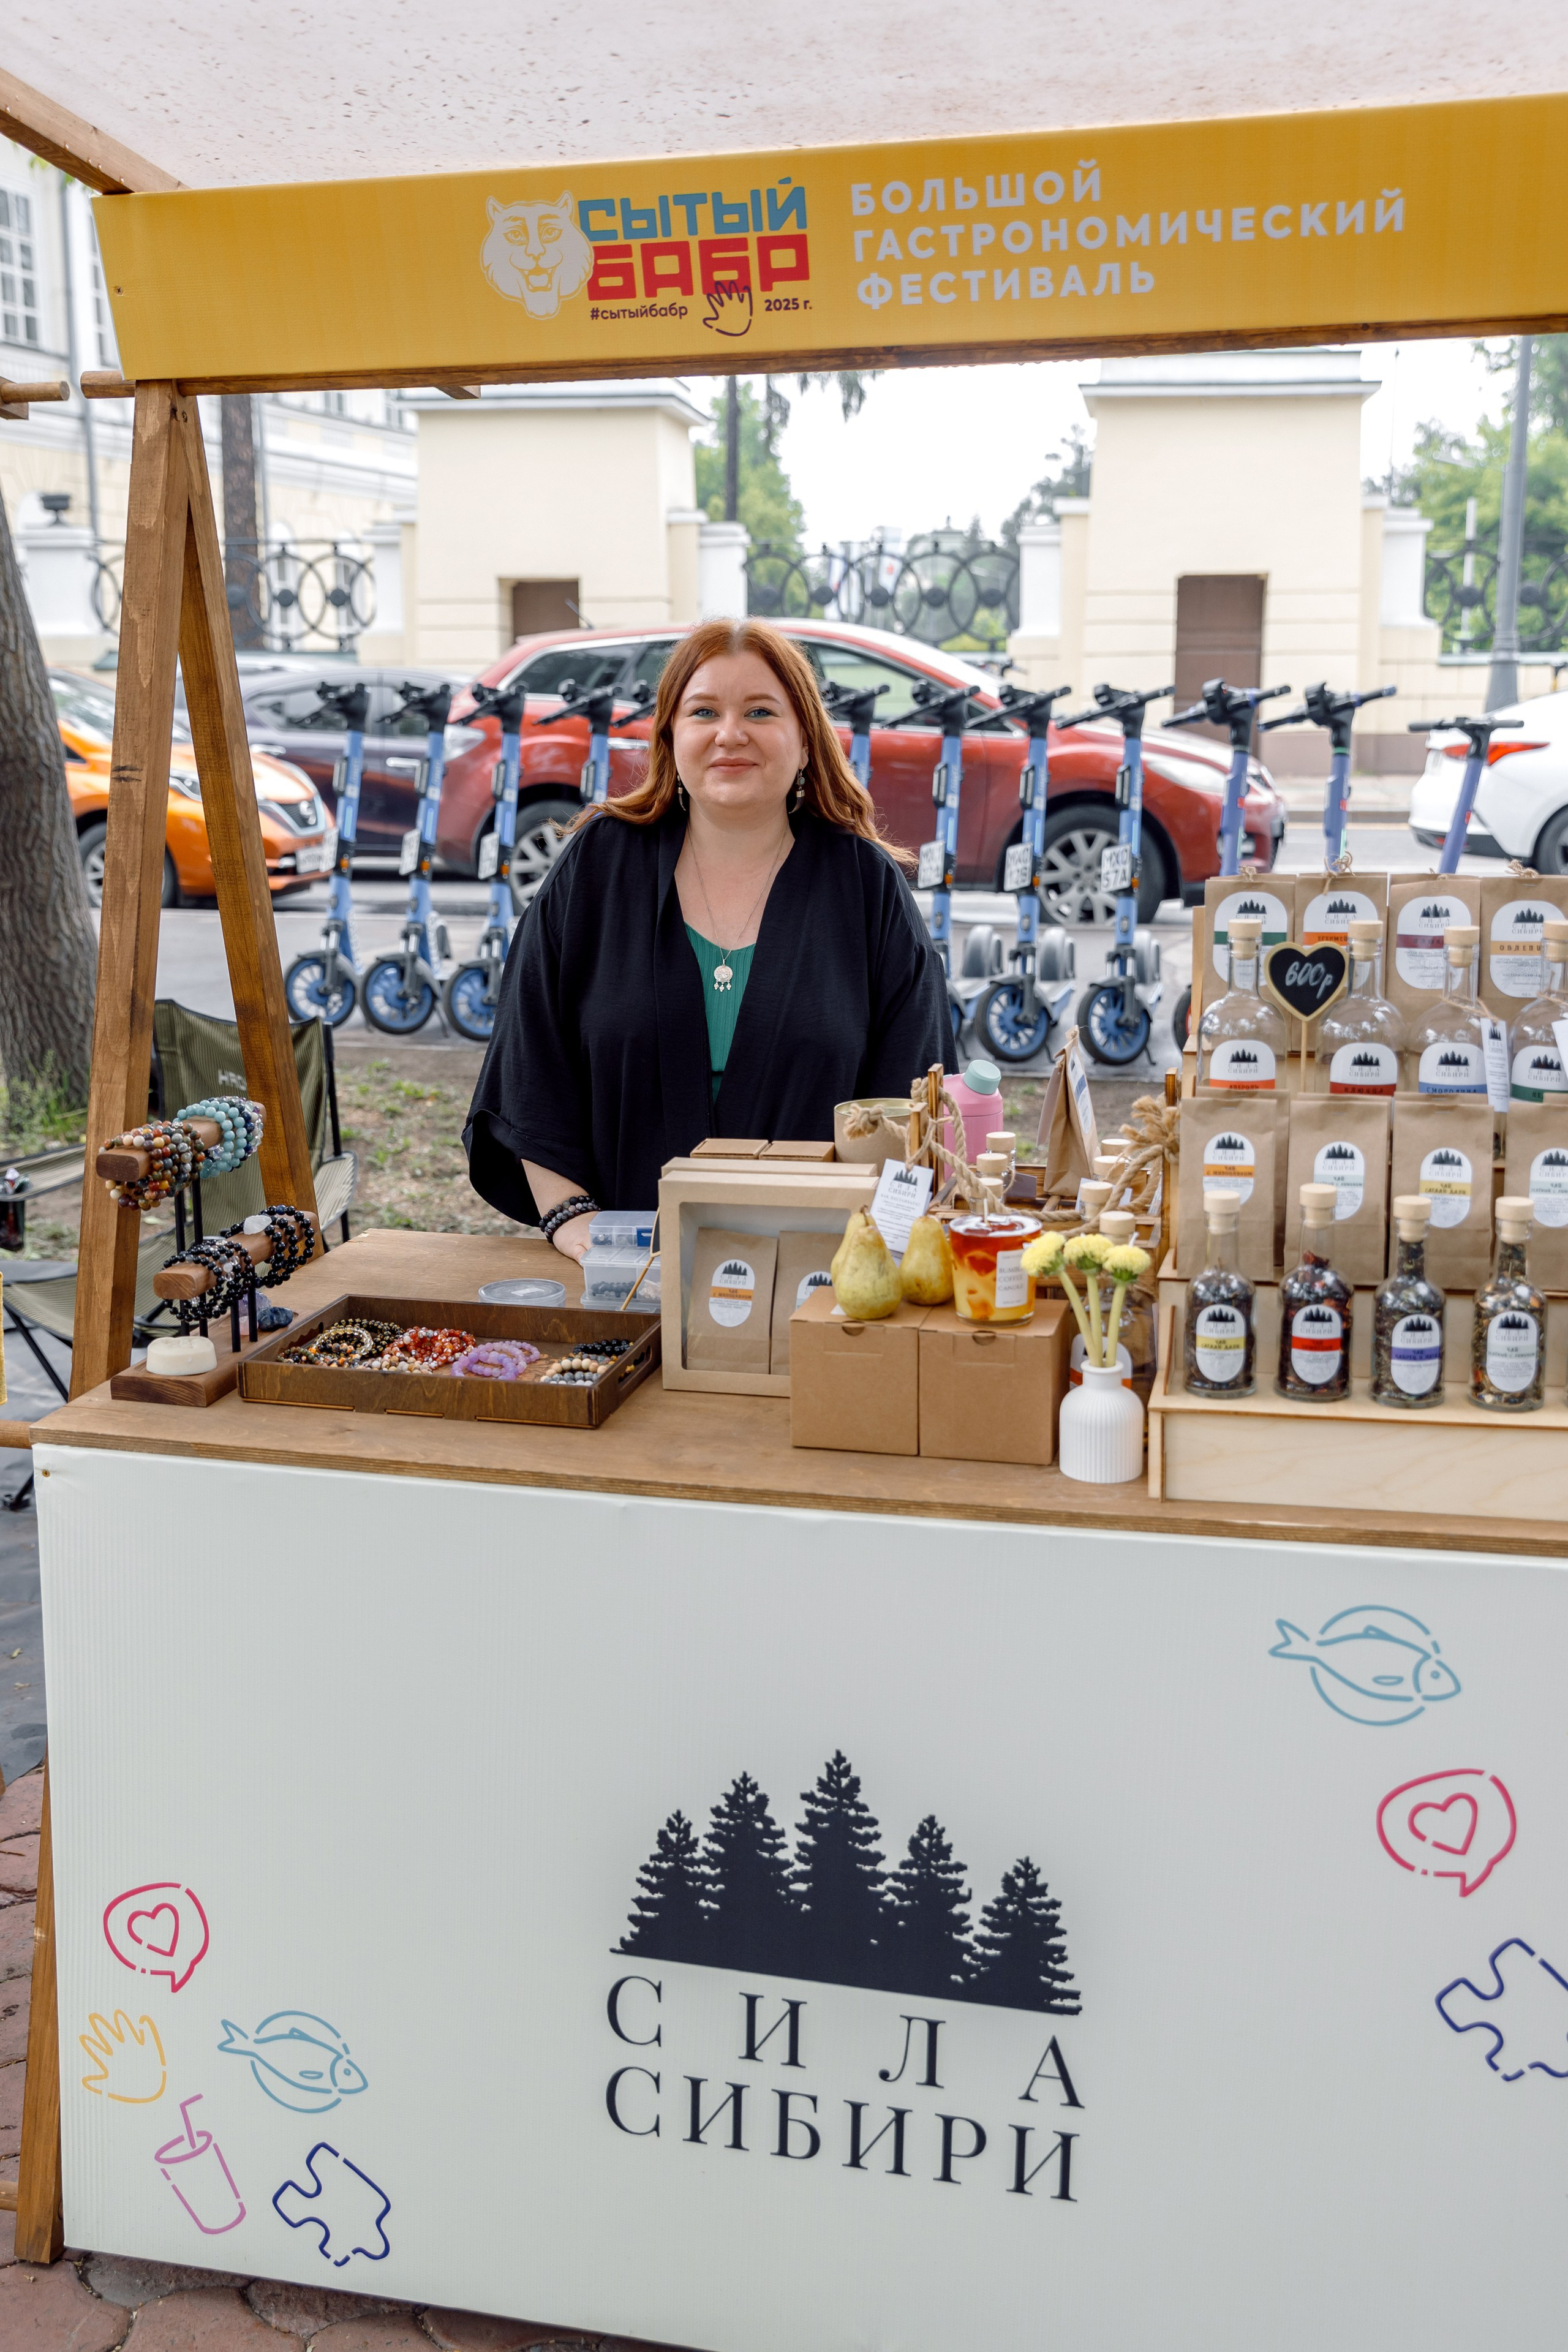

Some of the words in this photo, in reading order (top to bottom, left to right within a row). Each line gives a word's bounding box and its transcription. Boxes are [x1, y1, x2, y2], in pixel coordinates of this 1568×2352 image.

[578, 176, 807, 242] СЫТЫЙ
[850, 158, 1102, 216] БОЛЬШОЙ
[853, 187, 1405, 262] ГАСТРОНОМИЧЕСКИЙ
[586, 233, 810, 301] БАБР
[857, 261, 1156, 311] ФЕСТИВАЛЬ
[590, 302, 688, 321] #сытыйбабр
[764, 297, 799, 312] 2025
[802, 298, 813, 311] г.
[888, 1187, 916, 1199] СИБИРИ
[889, 1181, 917, 1193] СИЛА
[998, 1275, 1023, 1283] COFFEE
[607, 1975, 1085, 2109] СИЛА
[605, 2065, 1080, 2203] СИБИРИ
